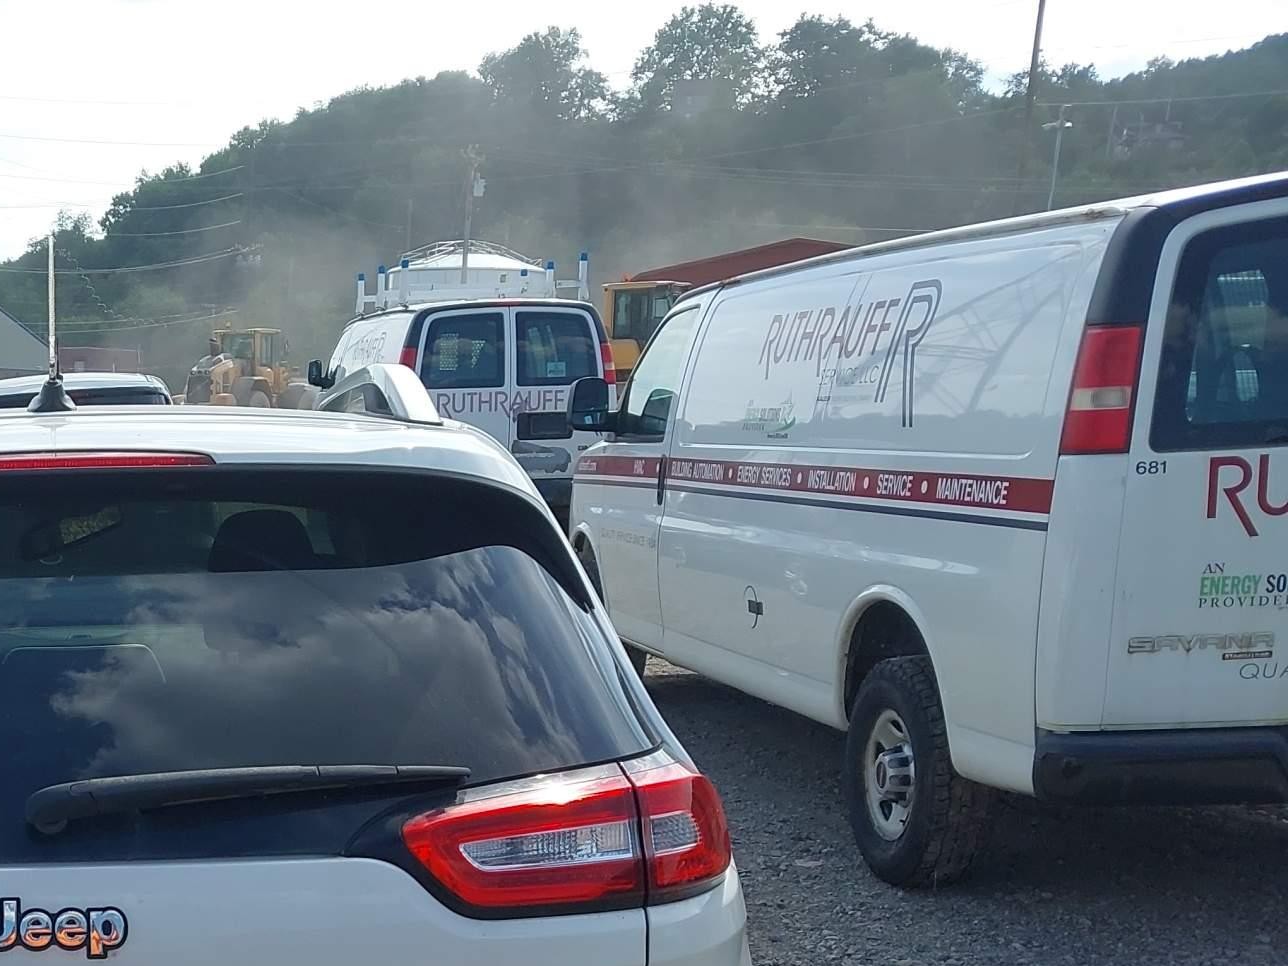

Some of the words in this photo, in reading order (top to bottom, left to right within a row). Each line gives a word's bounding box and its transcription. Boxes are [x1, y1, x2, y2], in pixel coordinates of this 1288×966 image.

[758, 297, 902, 380] RUTHRAUFF
[436, 389, 565, 419] RUTHRAUFF
[1135, 460, 1168, 475] 681
[671, 461, 692, 477] BUILDING
[693, 462, 725, 481] AUTOMATION
[737, 465, 760, 483] ENERGY
[761, 467, 792, 487] SERVICES
[807, 470, 857, 492] INSTALLATION
[876, 474, 913, 497] SERVICE
[936, 478, 1010, 504] MAINTENANCE
[1202, 562, 1226, 575] AN
[1199, 574, 1262, 597] ENERGY
